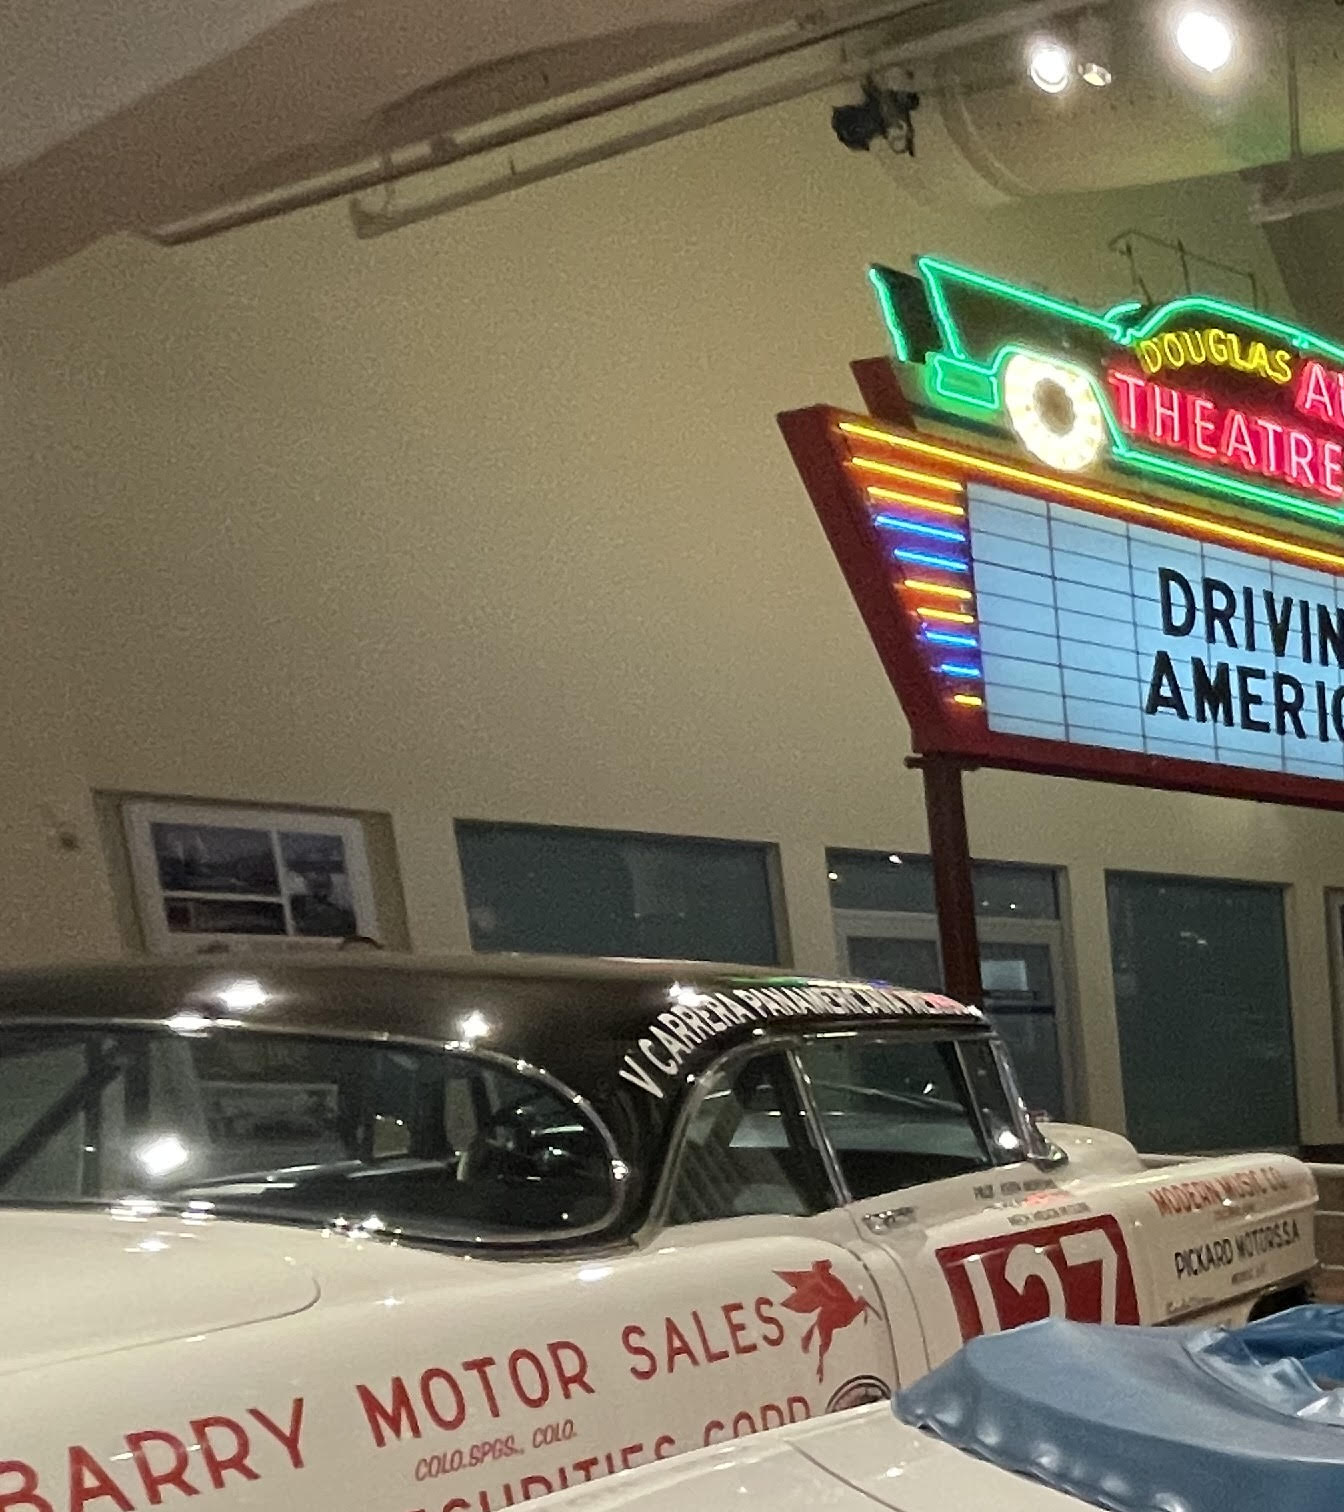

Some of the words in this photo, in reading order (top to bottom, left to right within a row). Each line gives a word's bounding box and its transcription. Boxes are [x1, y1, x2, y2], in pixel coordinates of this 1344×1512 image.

[1140, 326, 1293, 384] DOUGLAS
[638, 990, 757, 1076] CARRERA
[620, 1055, 665, 1099] V
[1149, 1180, 1223, 1217] MODERN
[963, 1228, 1118, 1335] 127
[1174, 1237, 1234, 1280] PICKARD
[356, 1339, 596, 1448] MOTOR
[621, 1296, 785, 1381] SALES
